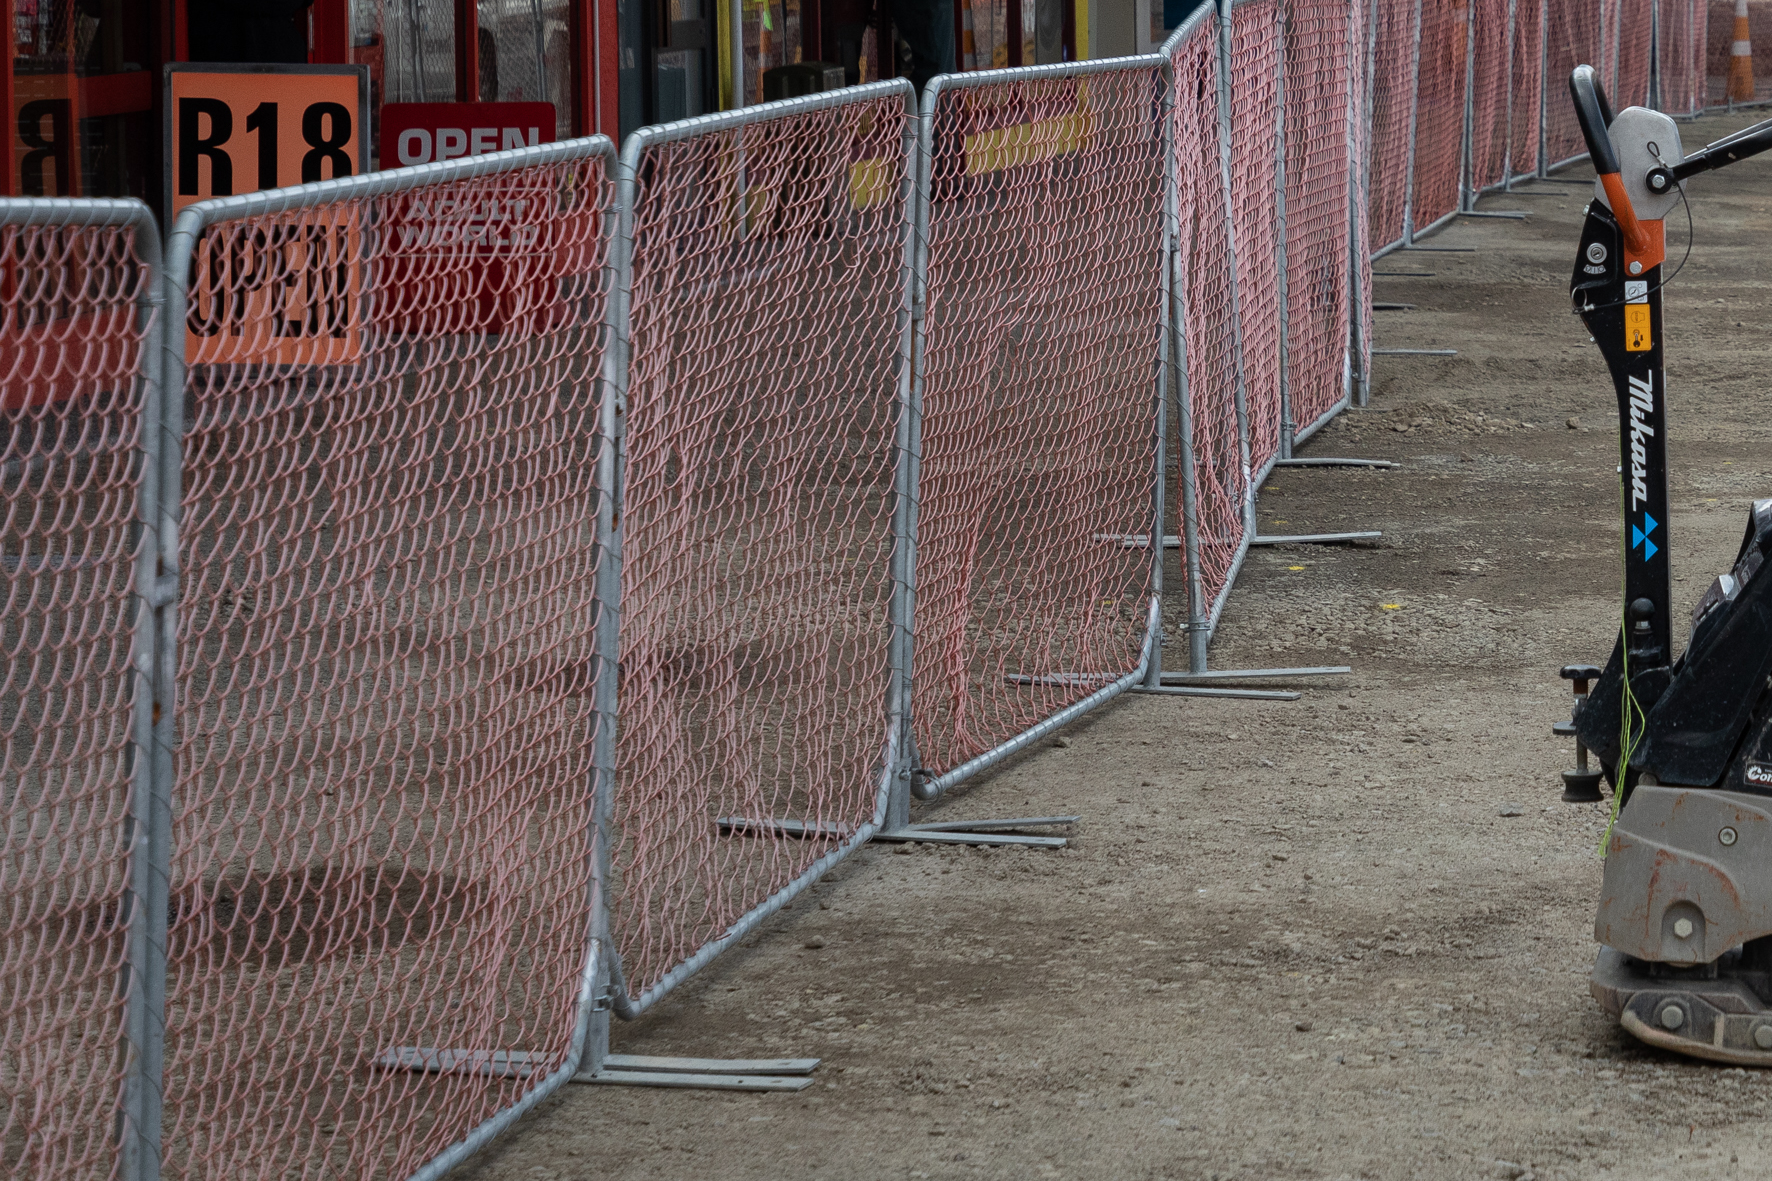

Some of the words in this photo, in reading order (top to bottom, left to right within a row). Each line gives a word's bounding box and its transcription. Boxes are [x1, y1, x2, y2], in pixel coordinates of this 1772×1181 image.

[178, 97, 353, 197] R18
[398, 126, 540, 165] OPEN
[186, 223, 349, 339] OPEN
[1627, 368, 1654, 512] Mikasa
